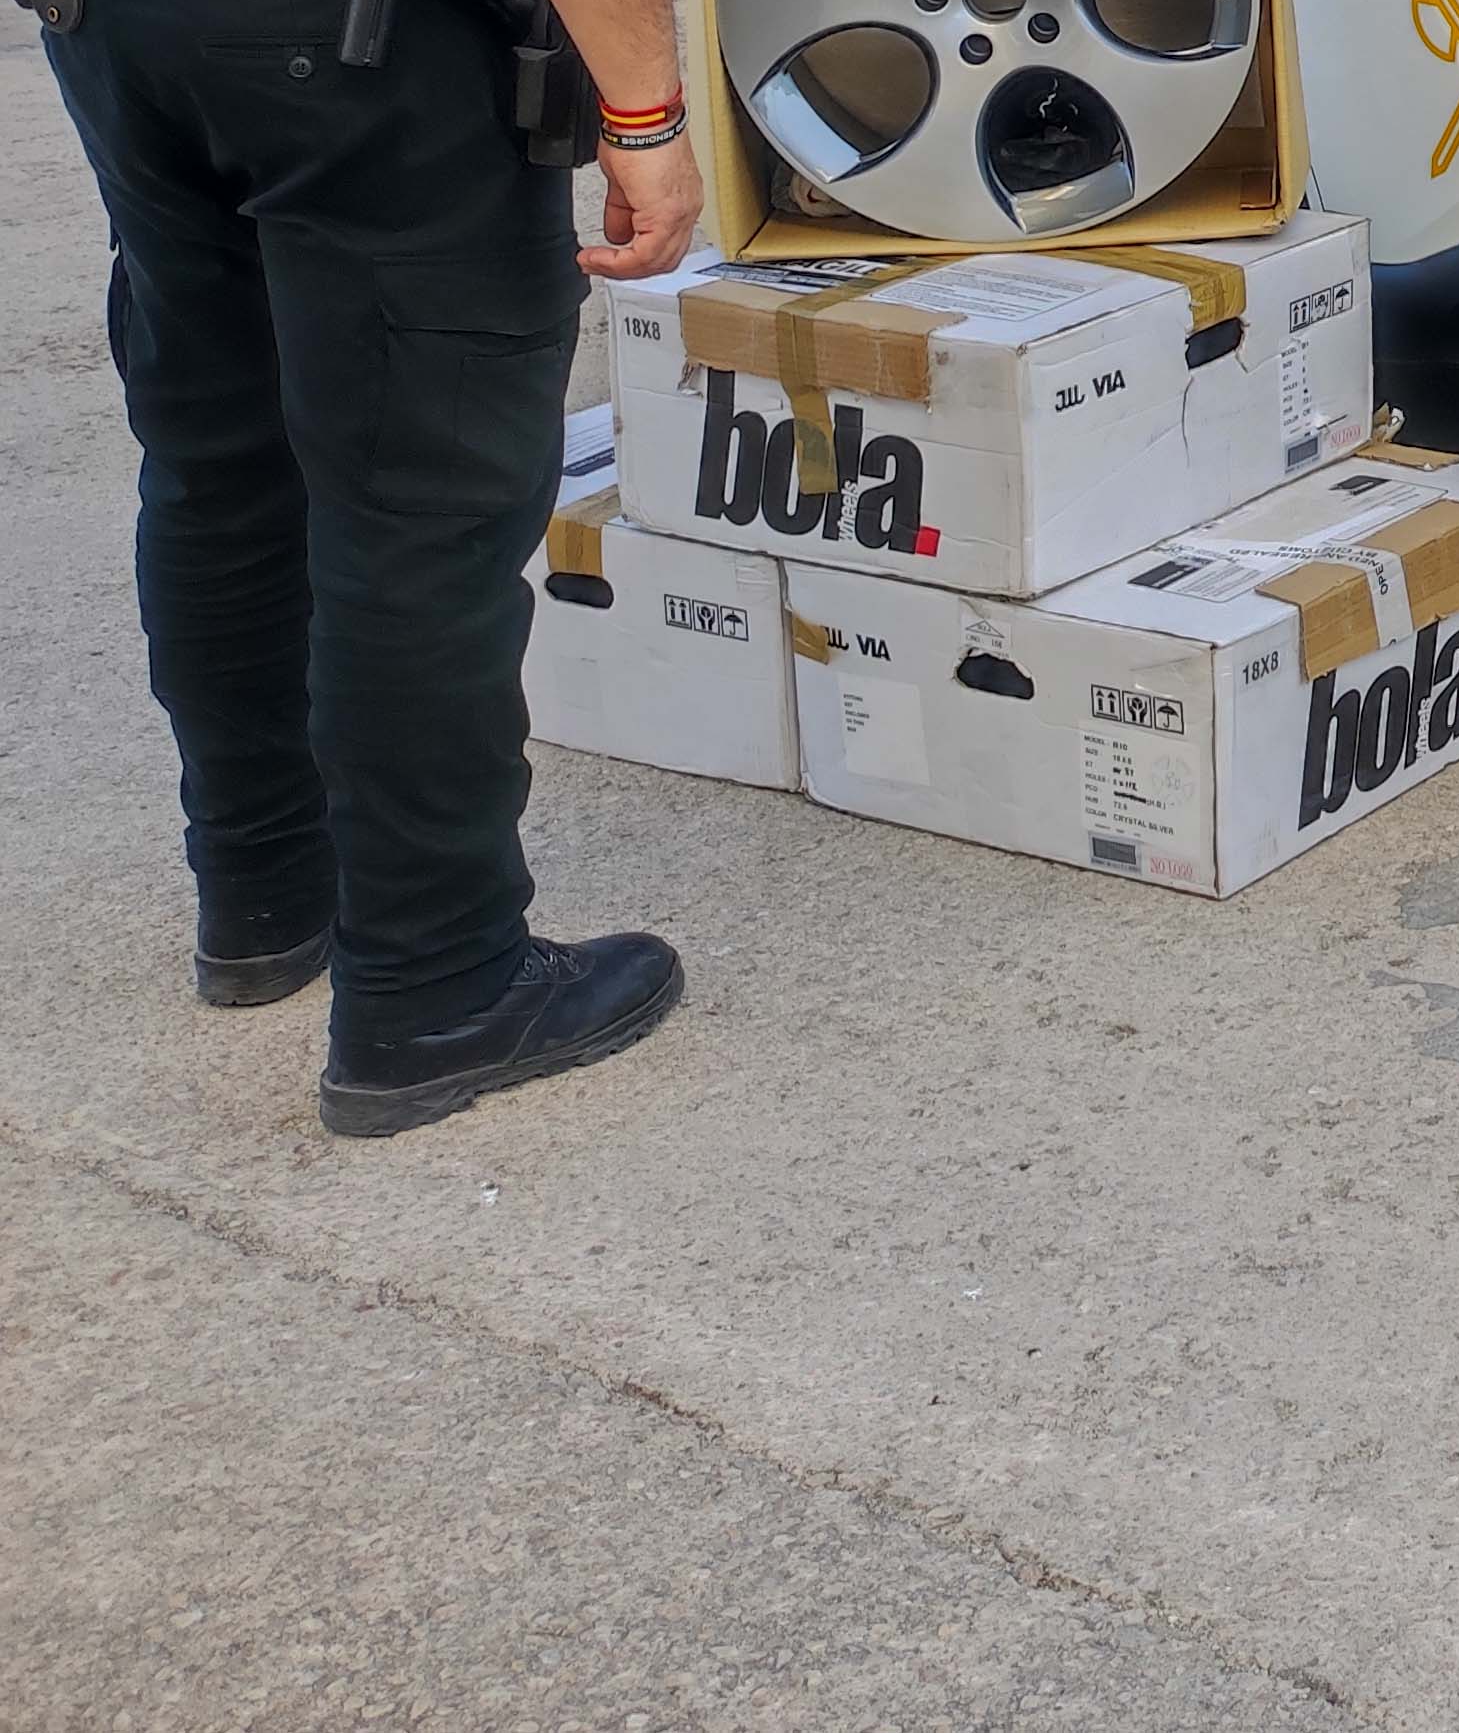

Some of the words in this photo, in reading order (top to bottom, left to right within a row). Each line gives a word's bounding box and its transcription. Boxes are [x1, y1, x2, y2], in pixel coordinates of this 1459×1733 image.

[623, 316, 661, 342] 18X8
[1092, 368, 1127, 398] VIA
[855, 633, 892, 663] VIA
[1242, 650, 1279, 686] 18X8
[1113, 814, 1147, 828] CRYSTAL
